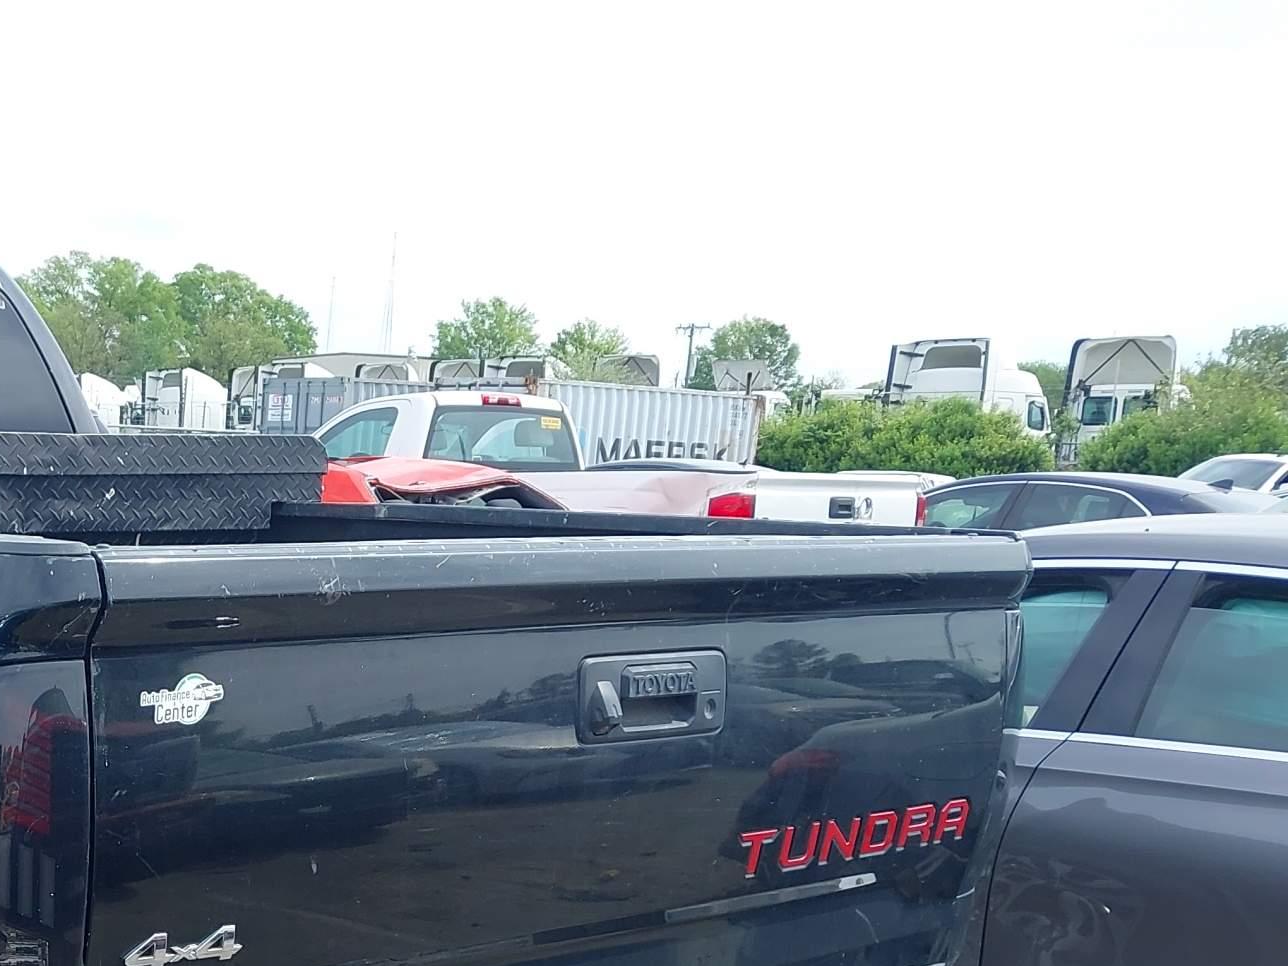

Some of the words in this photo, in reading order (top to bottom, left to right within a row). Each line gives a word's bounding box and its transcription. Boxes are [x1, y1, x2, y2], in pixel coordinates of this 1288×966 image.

[596, 437, 730, 464] MAERSK
[630, 671, 697, 698] TOYOTA
[156, 703, 200, 723] Center
[738, 797, 970, 879] TUNDRA
